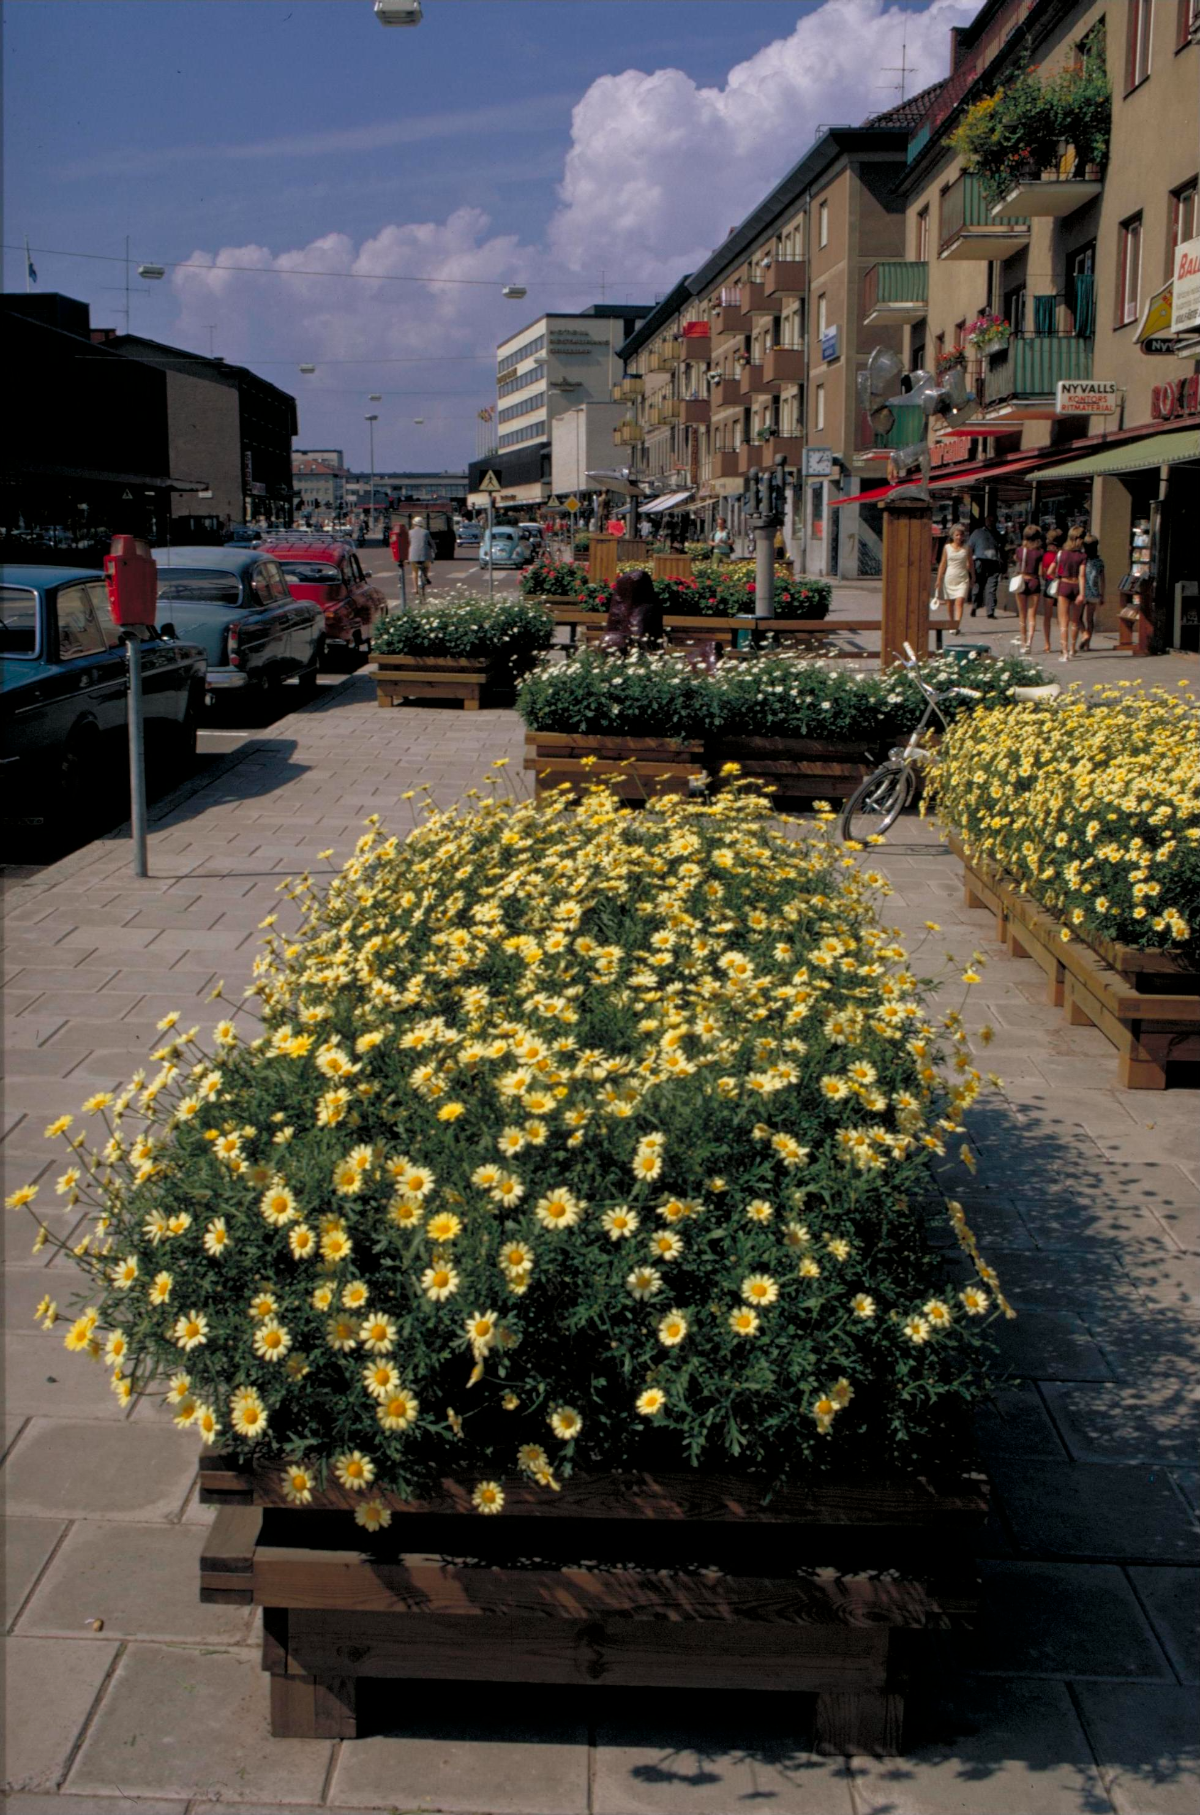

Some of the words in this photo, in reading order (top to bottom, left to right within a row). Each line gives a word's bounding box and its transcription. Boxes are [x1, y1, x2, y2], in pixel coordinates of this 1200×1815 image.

[1061, 384, 1115, 394] NYVALLS
[1068, 395, 1108, 403] KONTORS
[1061, 404, 1114, 412] RITMATERIAL
